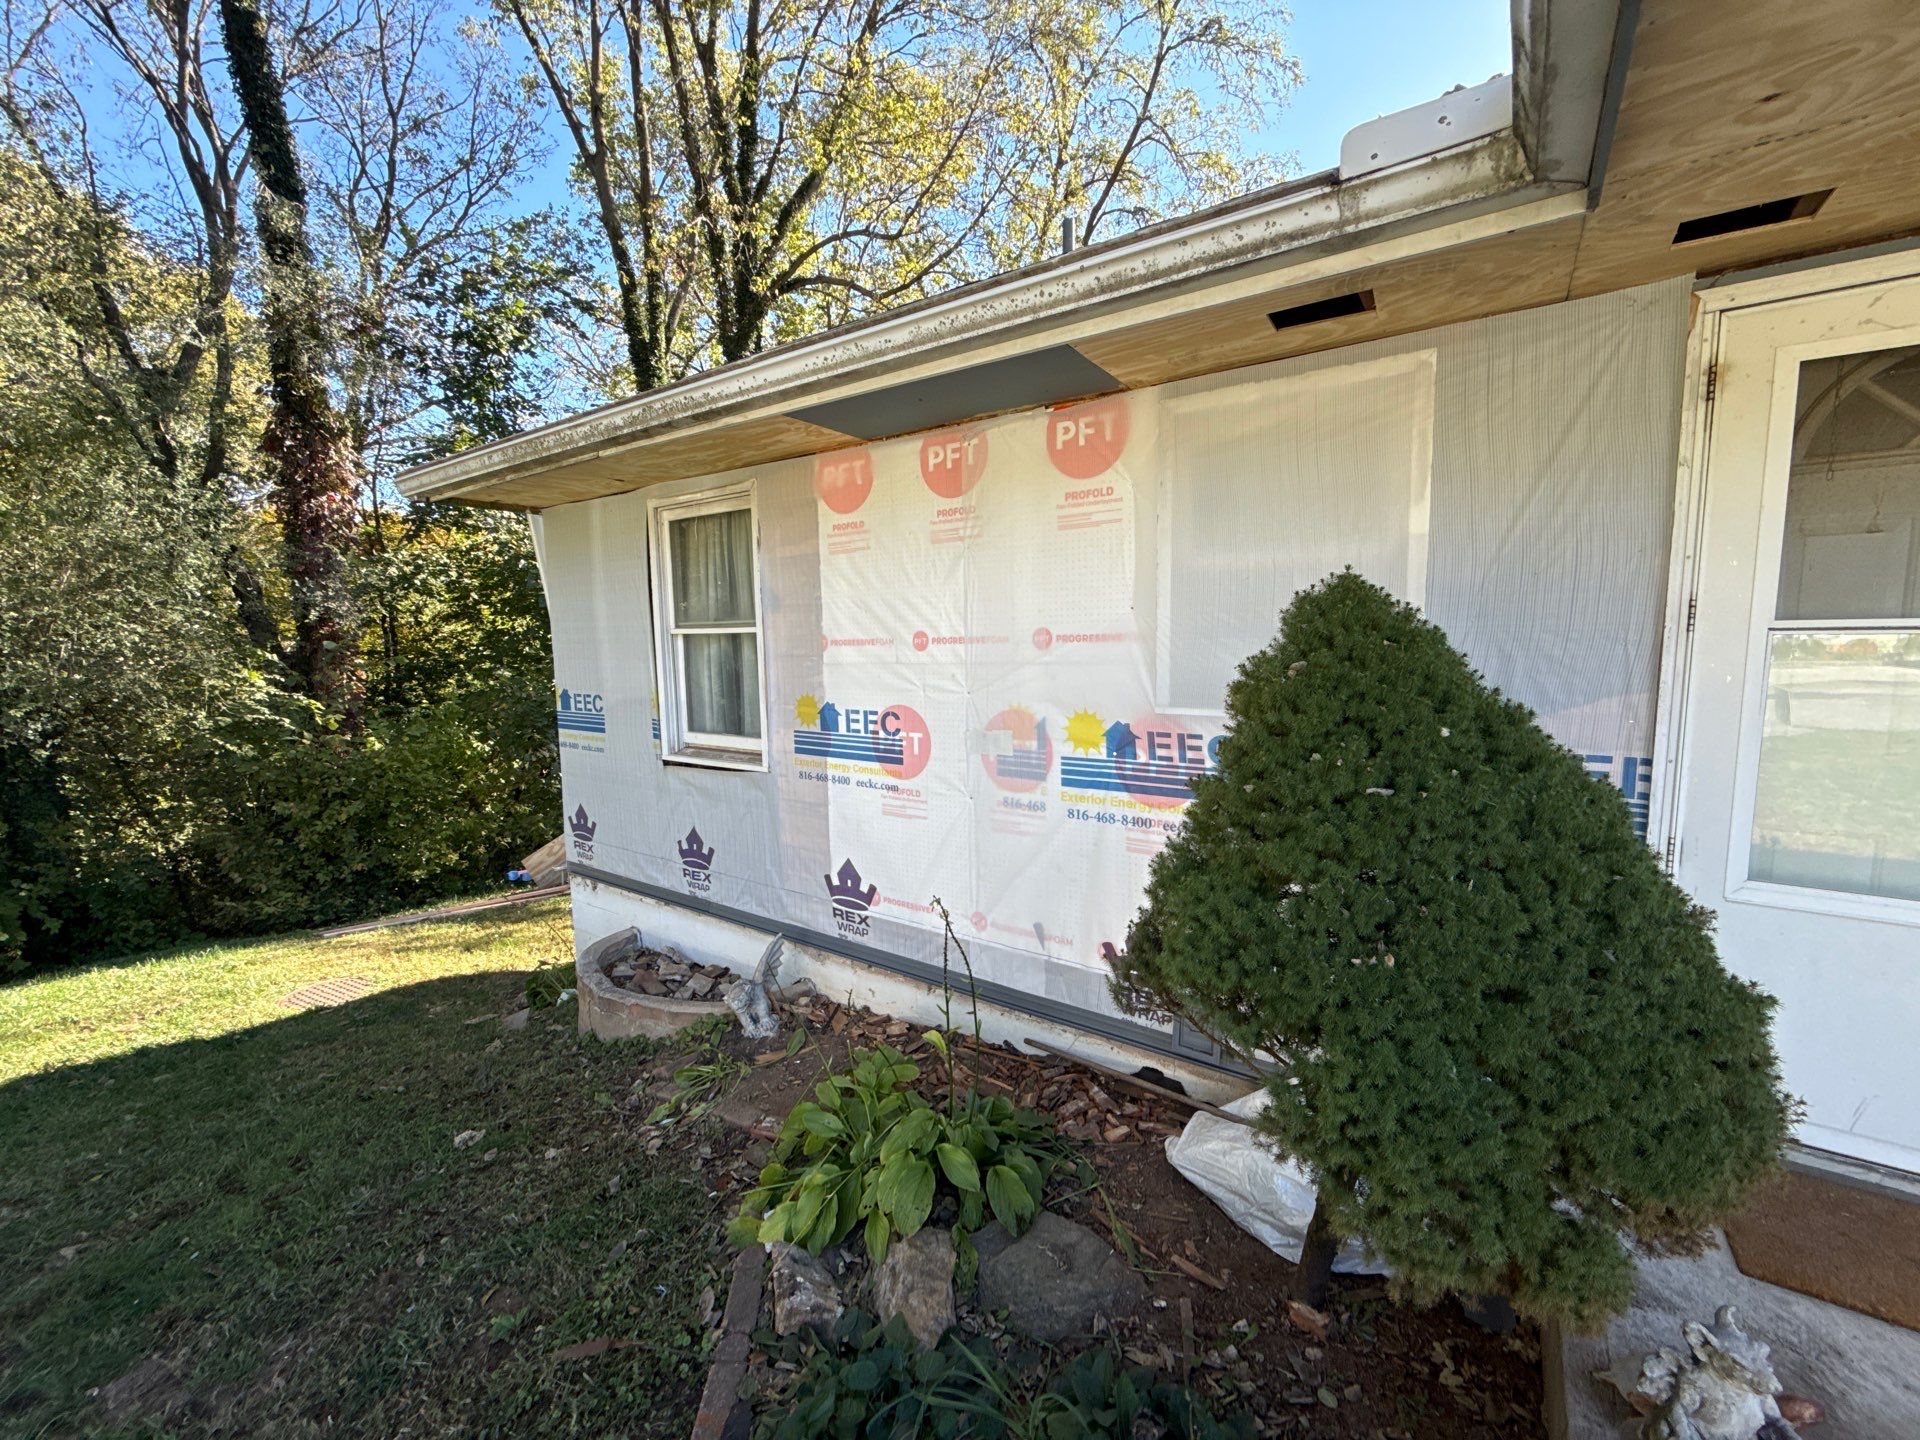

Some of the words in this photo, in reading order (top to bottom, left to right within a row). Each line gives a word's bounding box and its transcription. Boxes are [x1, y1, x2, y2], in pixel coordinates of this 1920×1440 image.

[1056, 410, 1117, 450] PFT
[928, 438, 978, 472] PFT
[821, 460, 866, 490] PFT
[1065, 486, 1114, 502] PROFOLD
[937, 505, 976, 518] PROFOLD
[832, 521, 865, 532] PROFOLD
[574, 693, 603, 713] EEC
[845, 709, 901, 737] EEC
[825, 761, 850, 773] Energy
[799, 771, 851, 786] 816-468-8400
[856, 779, 899, 793] eeckc.com
[1002, 797, 1047, 813] 816-468
[1060, 791, 1107, 806] Exterior
[1110, 796, 1152, 814] Energy
[1067, 808, 1152, 829] 816-468-8400
[574, 841, 594, 854] REX
[577, 852, 594, 862] WRAP
[682, 868, 712, 884] REX
[686, 879, 710, 892] WRAP
[832, 907, 871, 928] REX
[837, 921, 869, 937] WRAP
